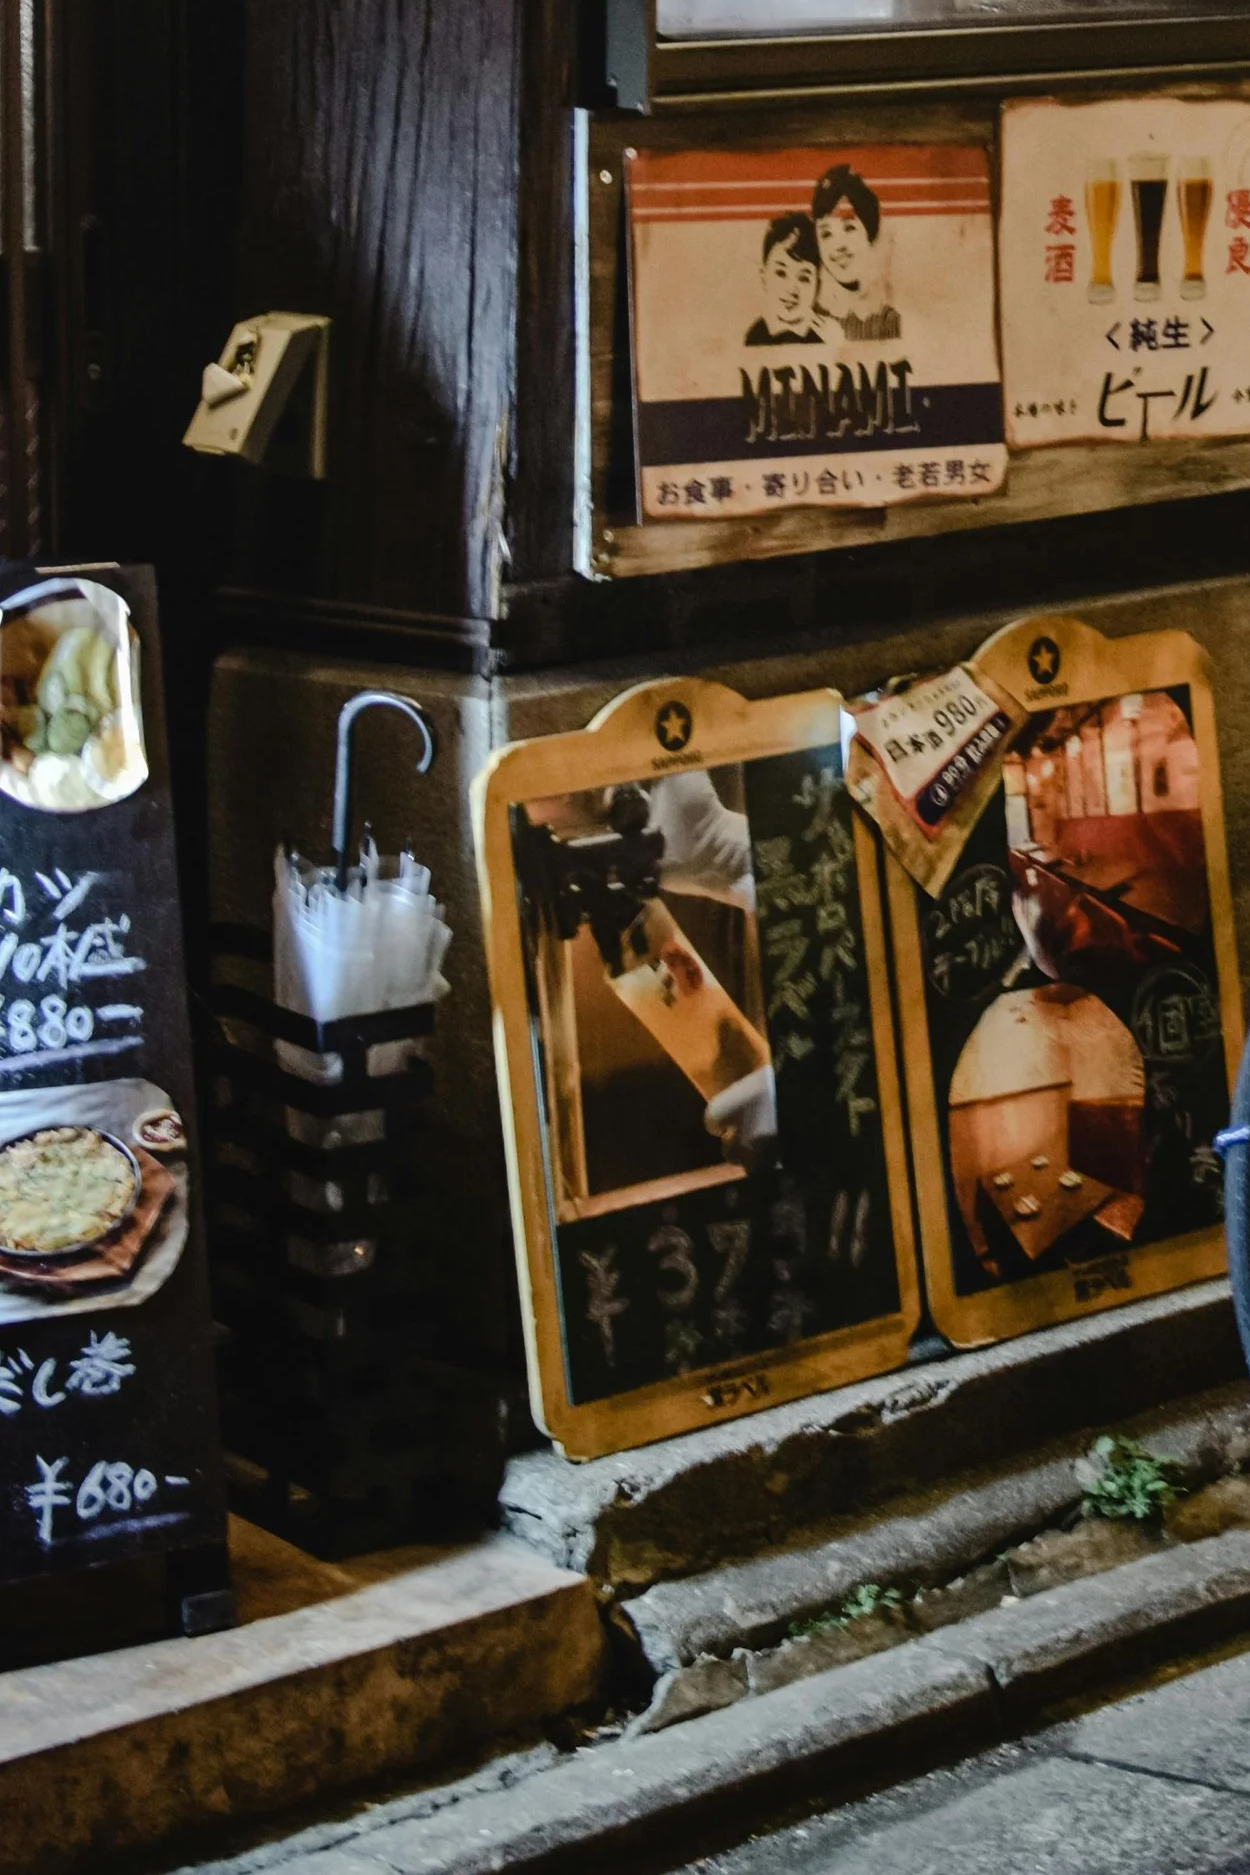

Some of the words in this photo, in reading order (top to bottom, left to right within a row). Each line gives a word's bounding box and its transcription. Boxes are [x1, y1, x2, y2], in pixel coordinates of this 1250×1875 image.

[1096, 366, 1219, 443] ビール
[655, 458, 992, 507] お食事・寄り合い・老若男女
